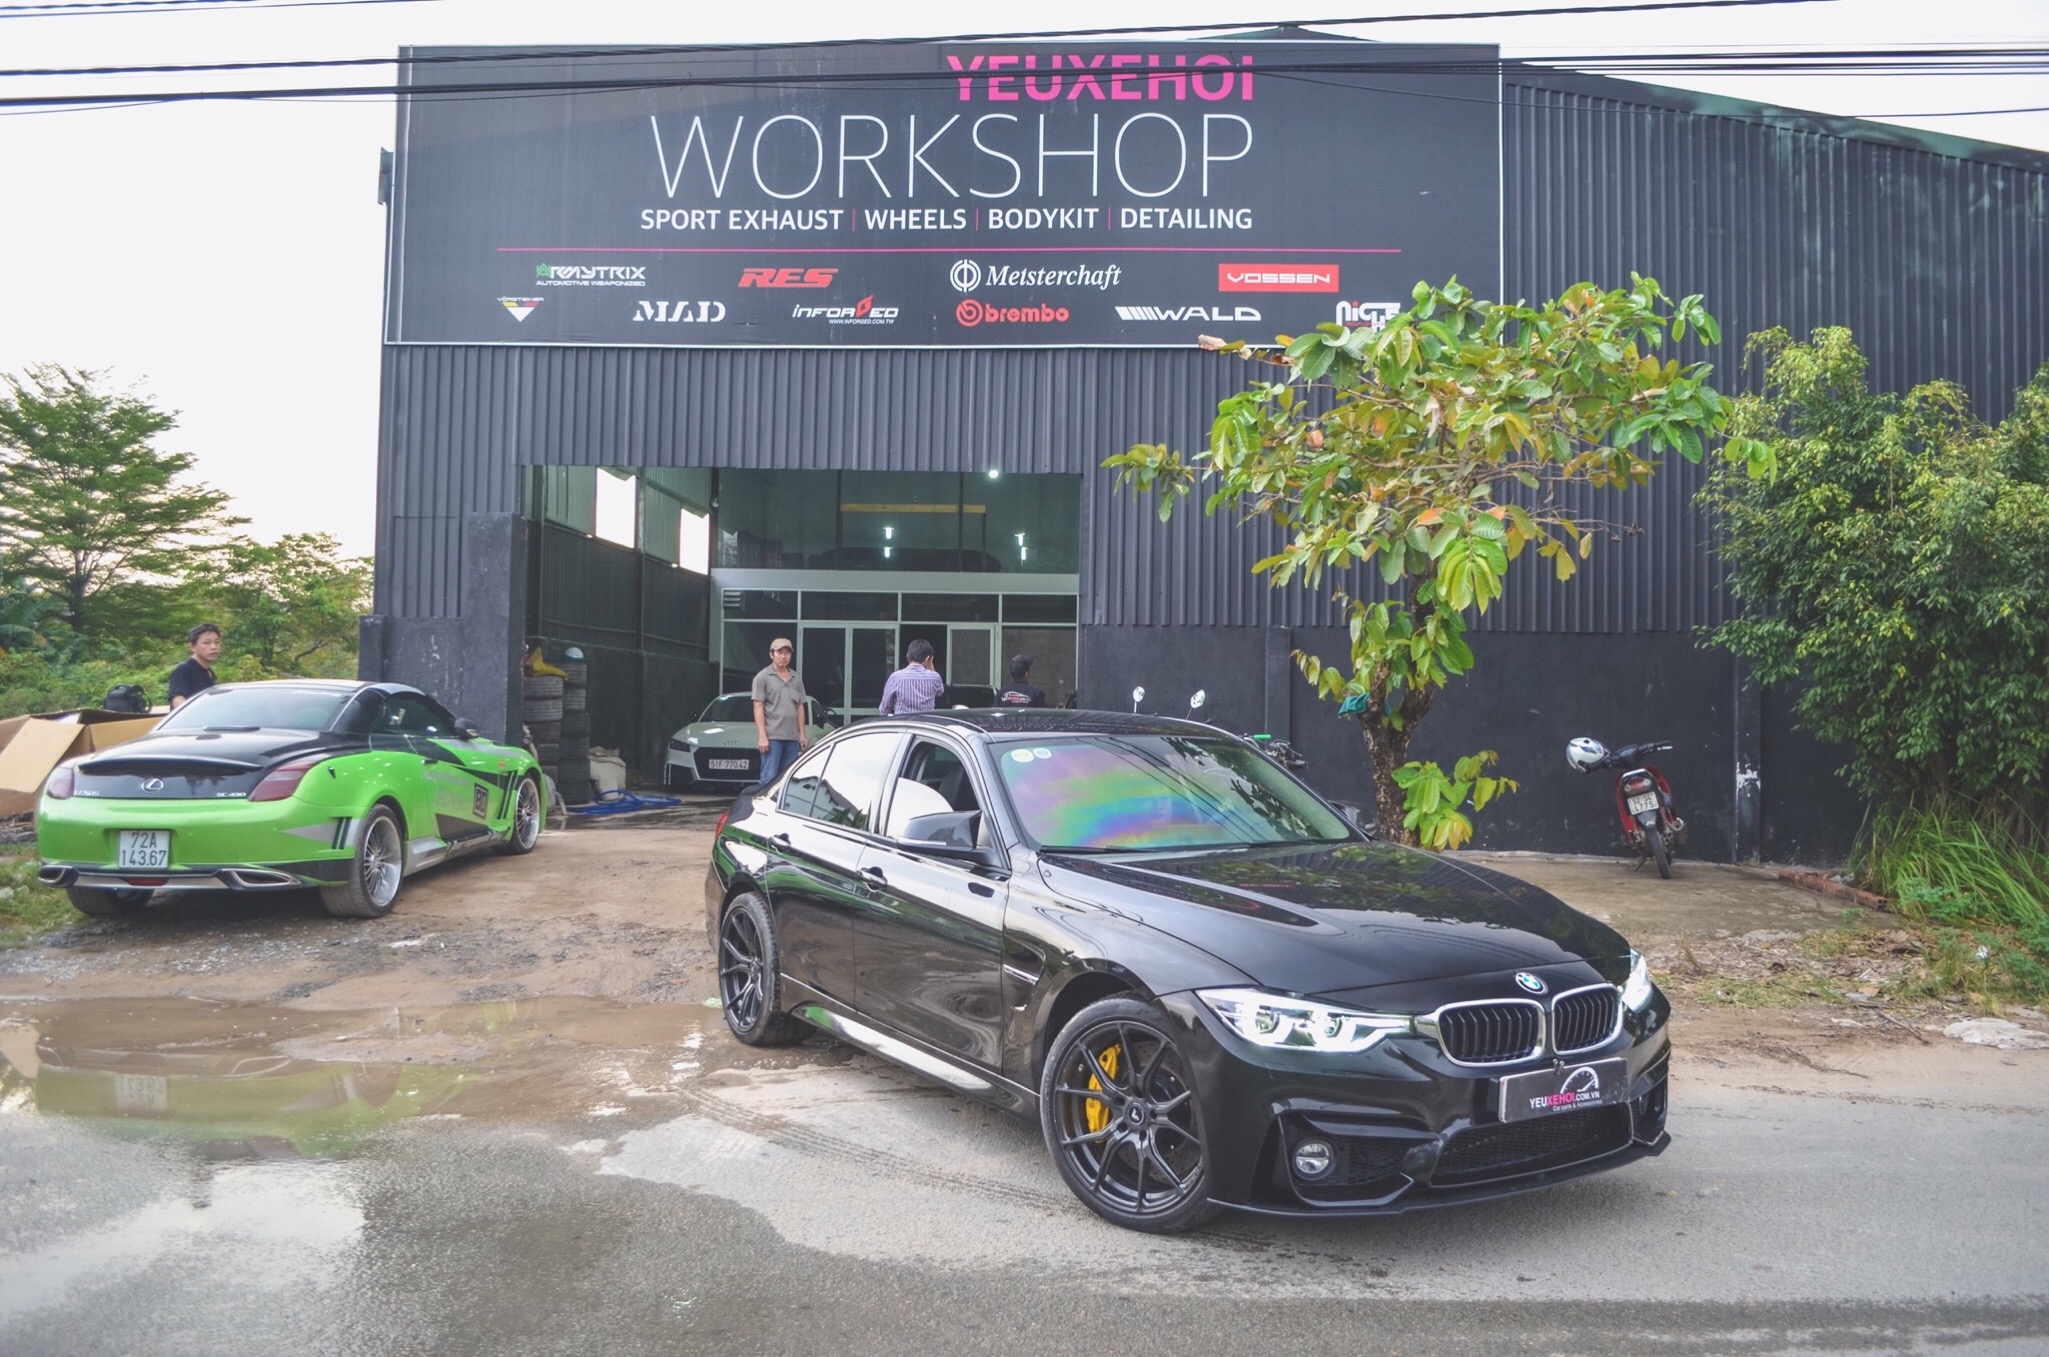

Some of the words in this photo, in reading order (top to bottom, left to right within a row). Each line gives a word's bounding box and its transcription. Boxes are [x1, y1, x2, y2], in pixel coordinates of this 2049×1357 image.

[946, 55, 1253, 101] YEUXEHOI
[650, 112, 1253, 199] WORKSHOP
[641, 208, 721, 230] SPORT
[728, 208, 844, 230] EXHAUST
[864, 208, 967, 230] WHEELS
[988, 208, 1099, 229] BODYKIT
[1120, 207, 1253, 229] DETAILING
[738, 268, 839, 288] RES
[985, 264, 1123, 291] Meisterchaft
[1227, 272, 1331, 284] VOSSEN
[633, 300, 727, 323] MAD
[985, 303, 1070, 323] brembo
[1153, 306, 1262, 321] WALD
[131, 832, 158, 849] 72A
[121, 850, 167, 867] 143.67
